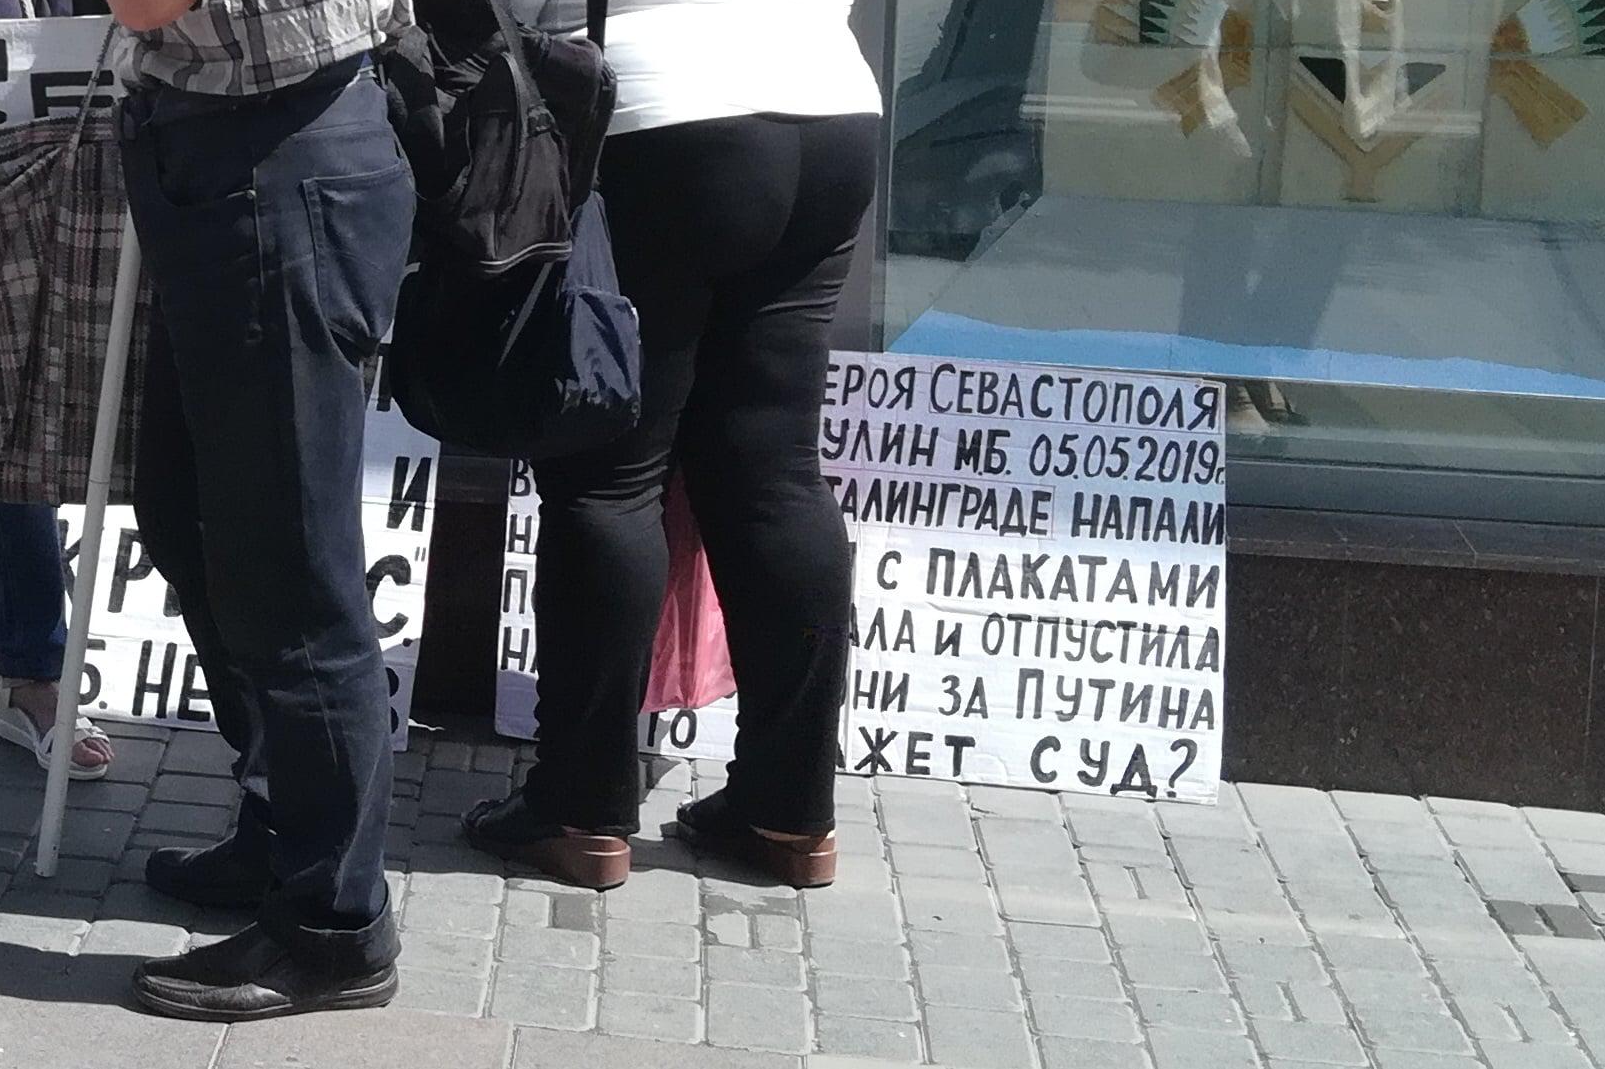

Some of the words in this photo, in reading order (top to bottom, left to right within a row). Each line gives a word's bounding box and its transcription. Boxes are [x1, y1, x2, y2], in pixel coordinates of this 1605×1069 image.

[930, 363, 1219, 431] СЕВАСТОПОЛЯ
[821, 416, 939, 467] УЛИН
[1070, 491, 1225, 546] НАПАЛИ
[926, 547, 1221, 609] ПЛАКАТАМИ
[981, 612, 1220, 673] ОТПУСТИЛА
[938, 674, 989, 720] ЗА
[1015, 667, 1216, 730] ПУТИНА
[836, 726, 976, 777] ЖЕТ
[1030, 735, 1198, 799] СУД?
